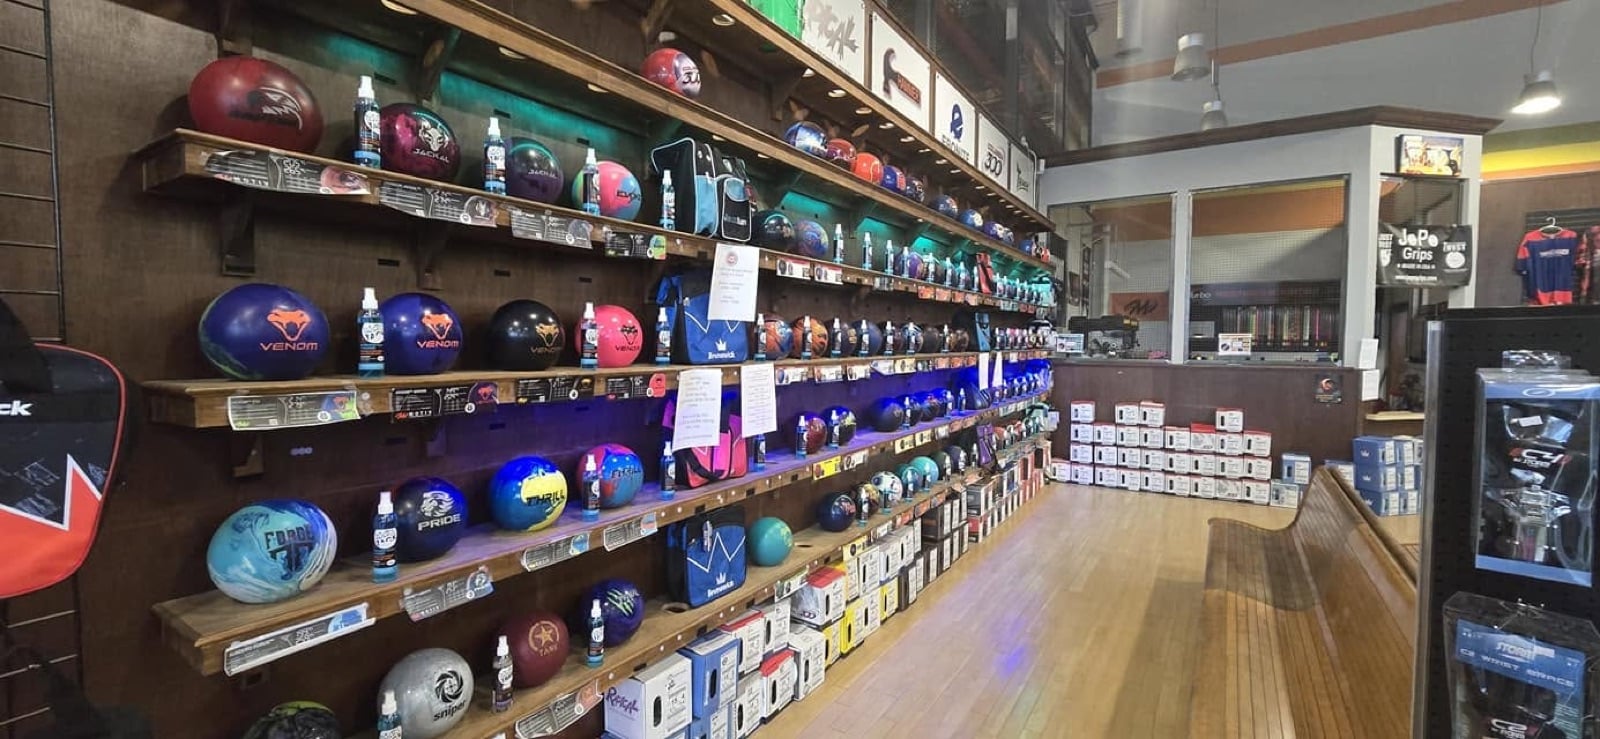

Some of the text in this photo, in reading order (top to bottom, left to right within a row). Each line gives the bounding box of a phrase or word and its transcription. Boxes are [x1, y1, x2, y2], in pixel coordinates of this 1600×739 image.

[413, 149, 449, 163] JACKAL
[984, 152, 1003, 176] 300
[1398, 228, 1439, 247] JoPo
[1403, 247, 1433, 262] Grips
[260, 342, 319, 351] VENOM
[417, 339, 459, 349] VENOM
[526, 489, 565, 506] THRILL
[417, 513, 461, 531] PRIDE
[433, 700, 465, 721] sniper
